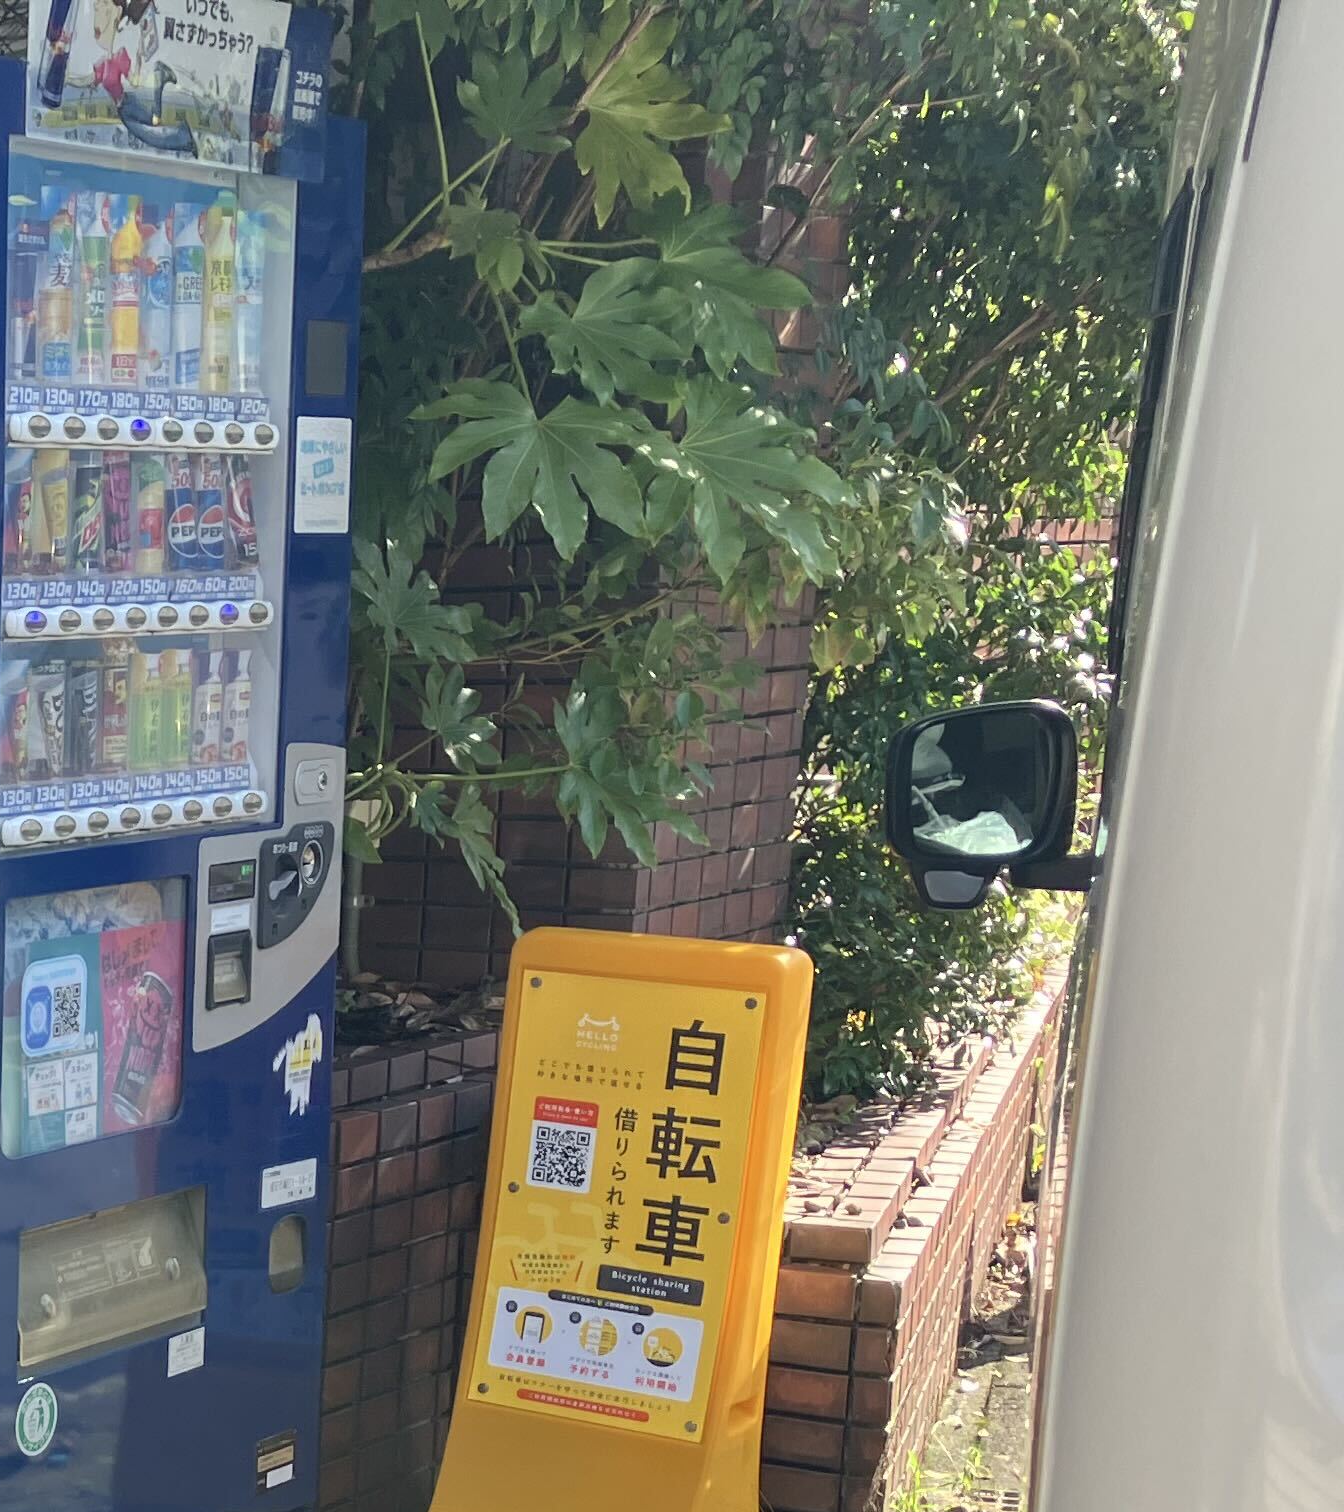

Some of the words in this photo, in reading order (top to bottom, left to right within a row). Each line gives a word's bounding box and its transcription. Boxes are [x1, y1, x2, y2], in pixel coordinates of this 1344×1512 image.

[600, 1106, 638, 1255] 借りられます
[634, 1019, 726, 1268] 自転車
[611, 1270, 648, 1285] Bicycle
[653, 1277, 690, 1293] sharing
[631, 1285, 667, 1297] station
